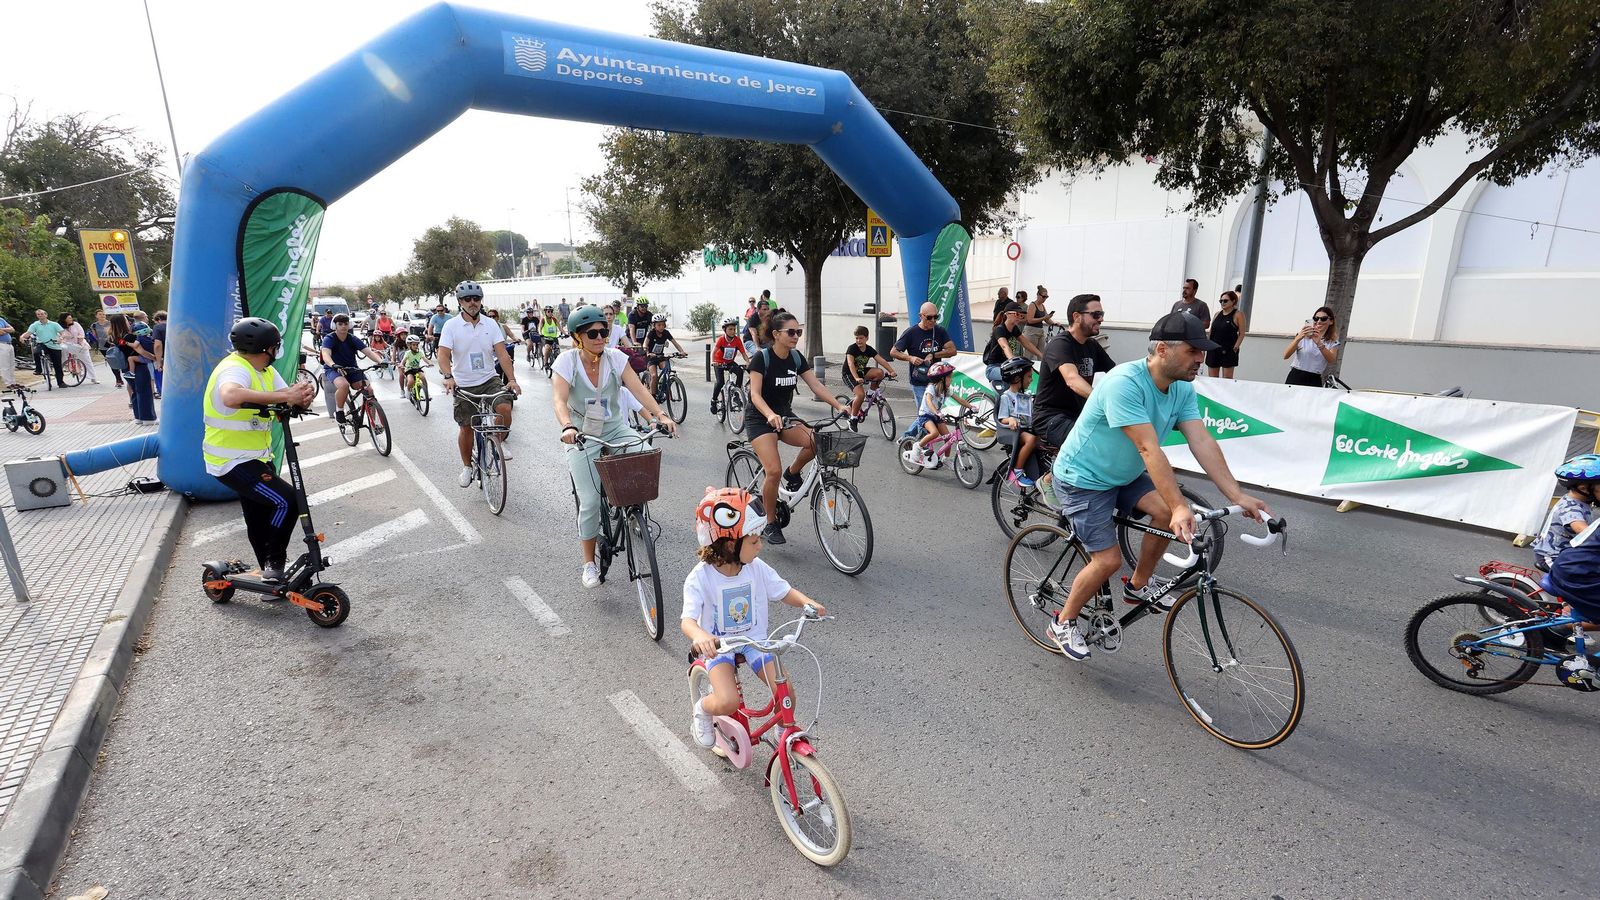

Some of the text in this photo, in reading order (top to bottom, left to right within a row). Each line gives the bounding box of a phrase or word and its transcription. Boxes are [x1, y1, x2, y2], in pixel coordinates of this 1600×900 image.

[556, 47, 817, 97] Ayuntamiento de Jerez
[556, 63, 644, 86] Deportes
[97, 280, 135, 289] PEATONES
[921, 345, 939, 353] AZOES
[775, 376, 797, 387] PUMA
[1202, 406, 1249, 434] Inglés
[1335, 434, 1469, 471] El Corte Inglés
[1146, 579, 1177, 602] TREK
